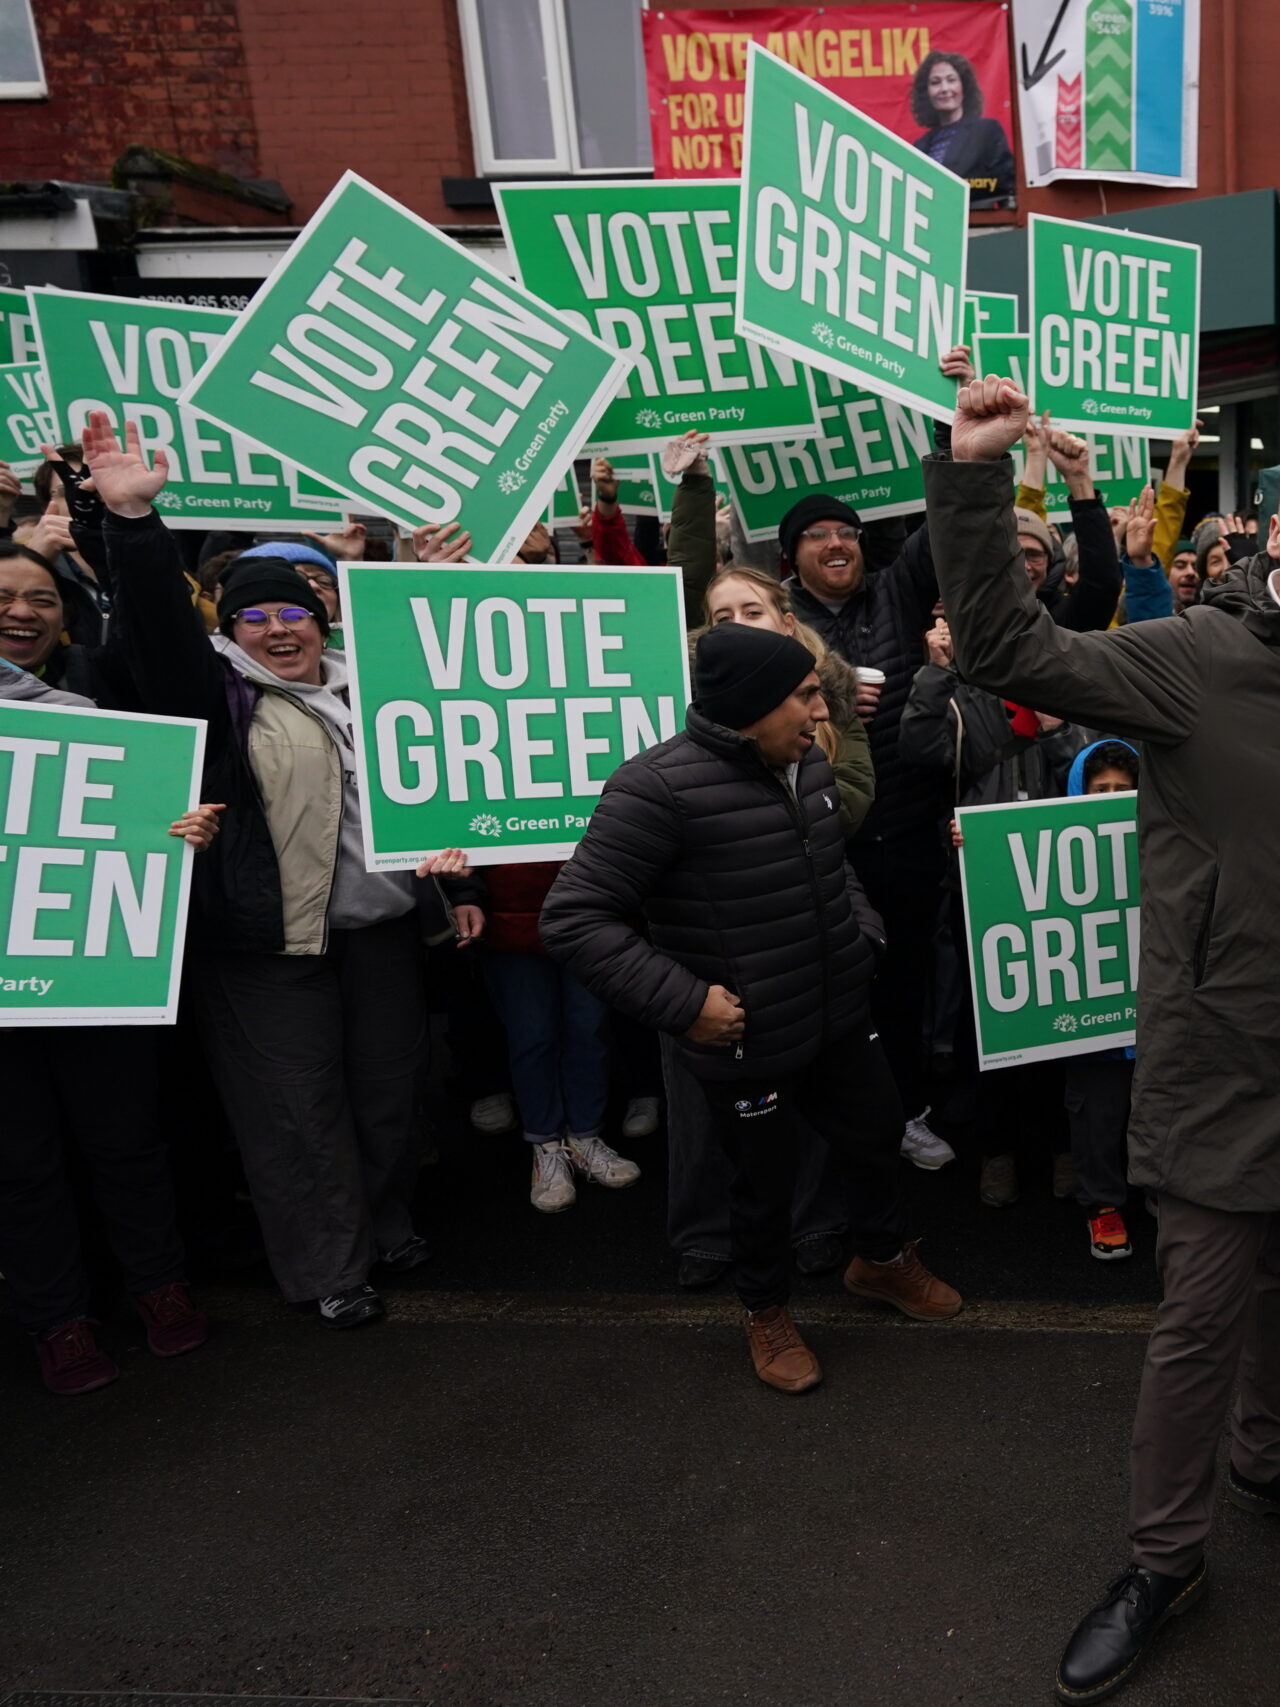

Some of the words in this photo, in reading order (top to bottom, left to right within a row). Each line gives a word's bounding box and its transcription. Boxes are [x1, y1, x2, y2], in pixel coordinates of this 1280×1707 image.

[662, 33, 748, 82] VOTE
[668, 93, 719, 130] FOR
[671, 134, 723, 171] NOT
[795, 102, 933, 265] VOTE
[553, 210, 738, 300] VOTE
[755, 185, 955, 361] GREEN
[1062, 244, 1172, 325] VOTE
[88, 320, 226, 400] VOT
[249, 236, 447, 428] VOTE
[836, 336, 873, 363] Green
[875, 351, 906, 378] Party
[1040, 313, 1191, 400] GREEN
[348, 276, 570, 526] GREEN
[514, 433, 548, 472] Green
[537, 399, 570, 435] Party
[663, 410, 706, 424] Green
[709, 406, 746, 421] Party
[1100, 403, 1127, 415] Green
[1128, 406, 1153, 420] Party
[185, 495, 231, 508] Green
[241, 496, 273, 512] Party
[861, 486, 892, 498] Party
[409, 597, 633, 691] VOTE
[0, 736, 126, 840] TE
[375, 695, 677, 806] GREEN
[505, 815, 560, 831] Green
[564, 813, 592, 828] Par
[1007, 820, 1137, 912] VOT
[981, 907, 1140, 1013] GRE
[1080, 1010, 1121, 1027] Green
[740, 1105, 777, 1118] Motorsport
